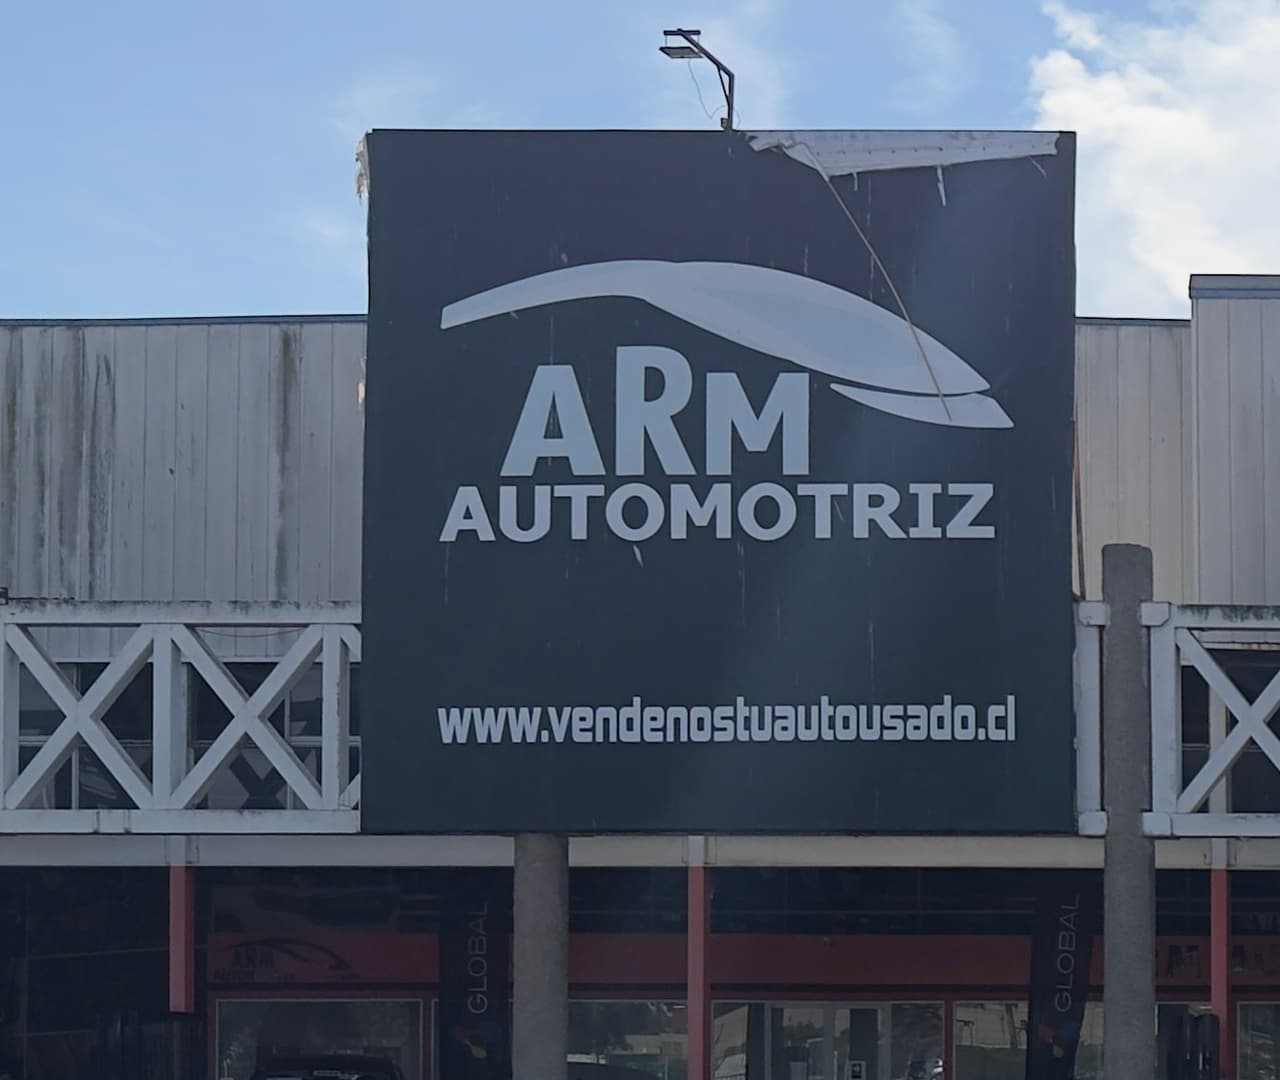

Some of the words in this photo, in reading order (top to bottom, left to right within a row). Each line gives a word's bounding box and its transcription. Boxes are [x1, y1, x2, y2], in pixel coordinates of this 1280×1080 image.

[500, 345, 811, 476] ARM
[438, 481, 996, 542] AUTOMOTRIZ
[437, 695, 1016, 744] www.vendenostuautousado.cl
[466, 900, 489, 1015] GLOBAL
[1054, 892, 1081, 1014] GLOBAL
